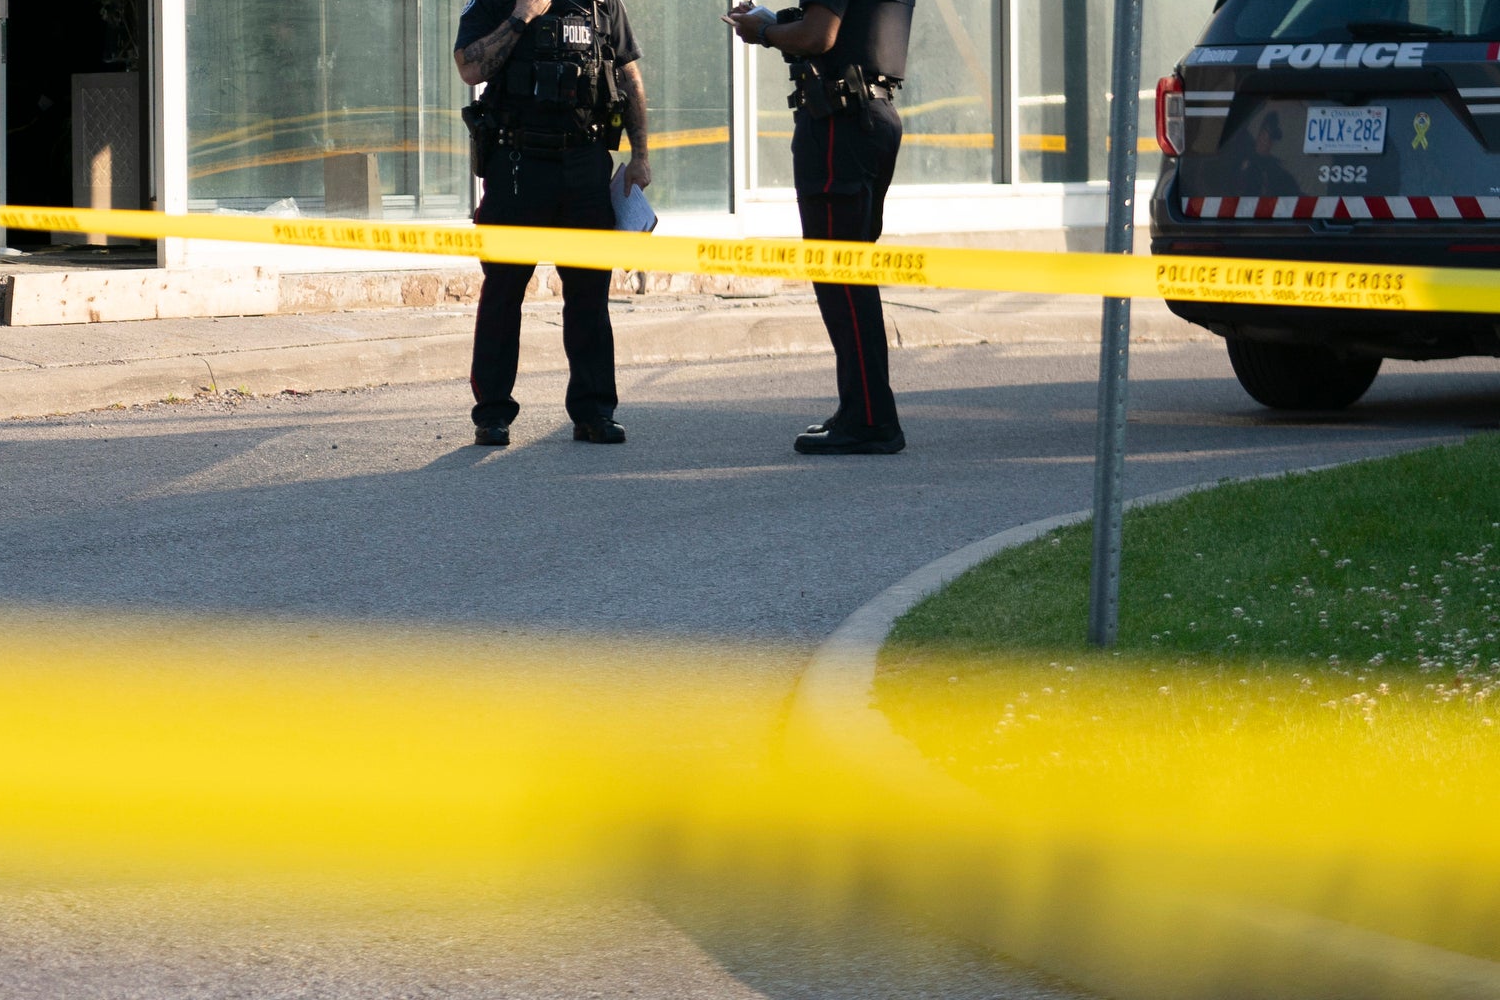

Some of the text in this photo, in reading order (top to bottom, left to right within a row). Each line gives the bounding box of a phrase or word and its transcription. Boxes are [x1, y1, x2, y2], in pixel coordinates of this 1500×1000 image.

[563, 24, 591, 44] POLICE
[1257, 43, 1428, 69] POLICE
[1308, 119, 1382, 141] CVLX 282
[273, 224, 484, 248] POLICE LINE DO NOT CROSS
[697, 243, 925, 270] POLICE LINE DO NOT CROSS
[1156, 264, 1405, 291] POLICE LINE DO NOT CROSS
